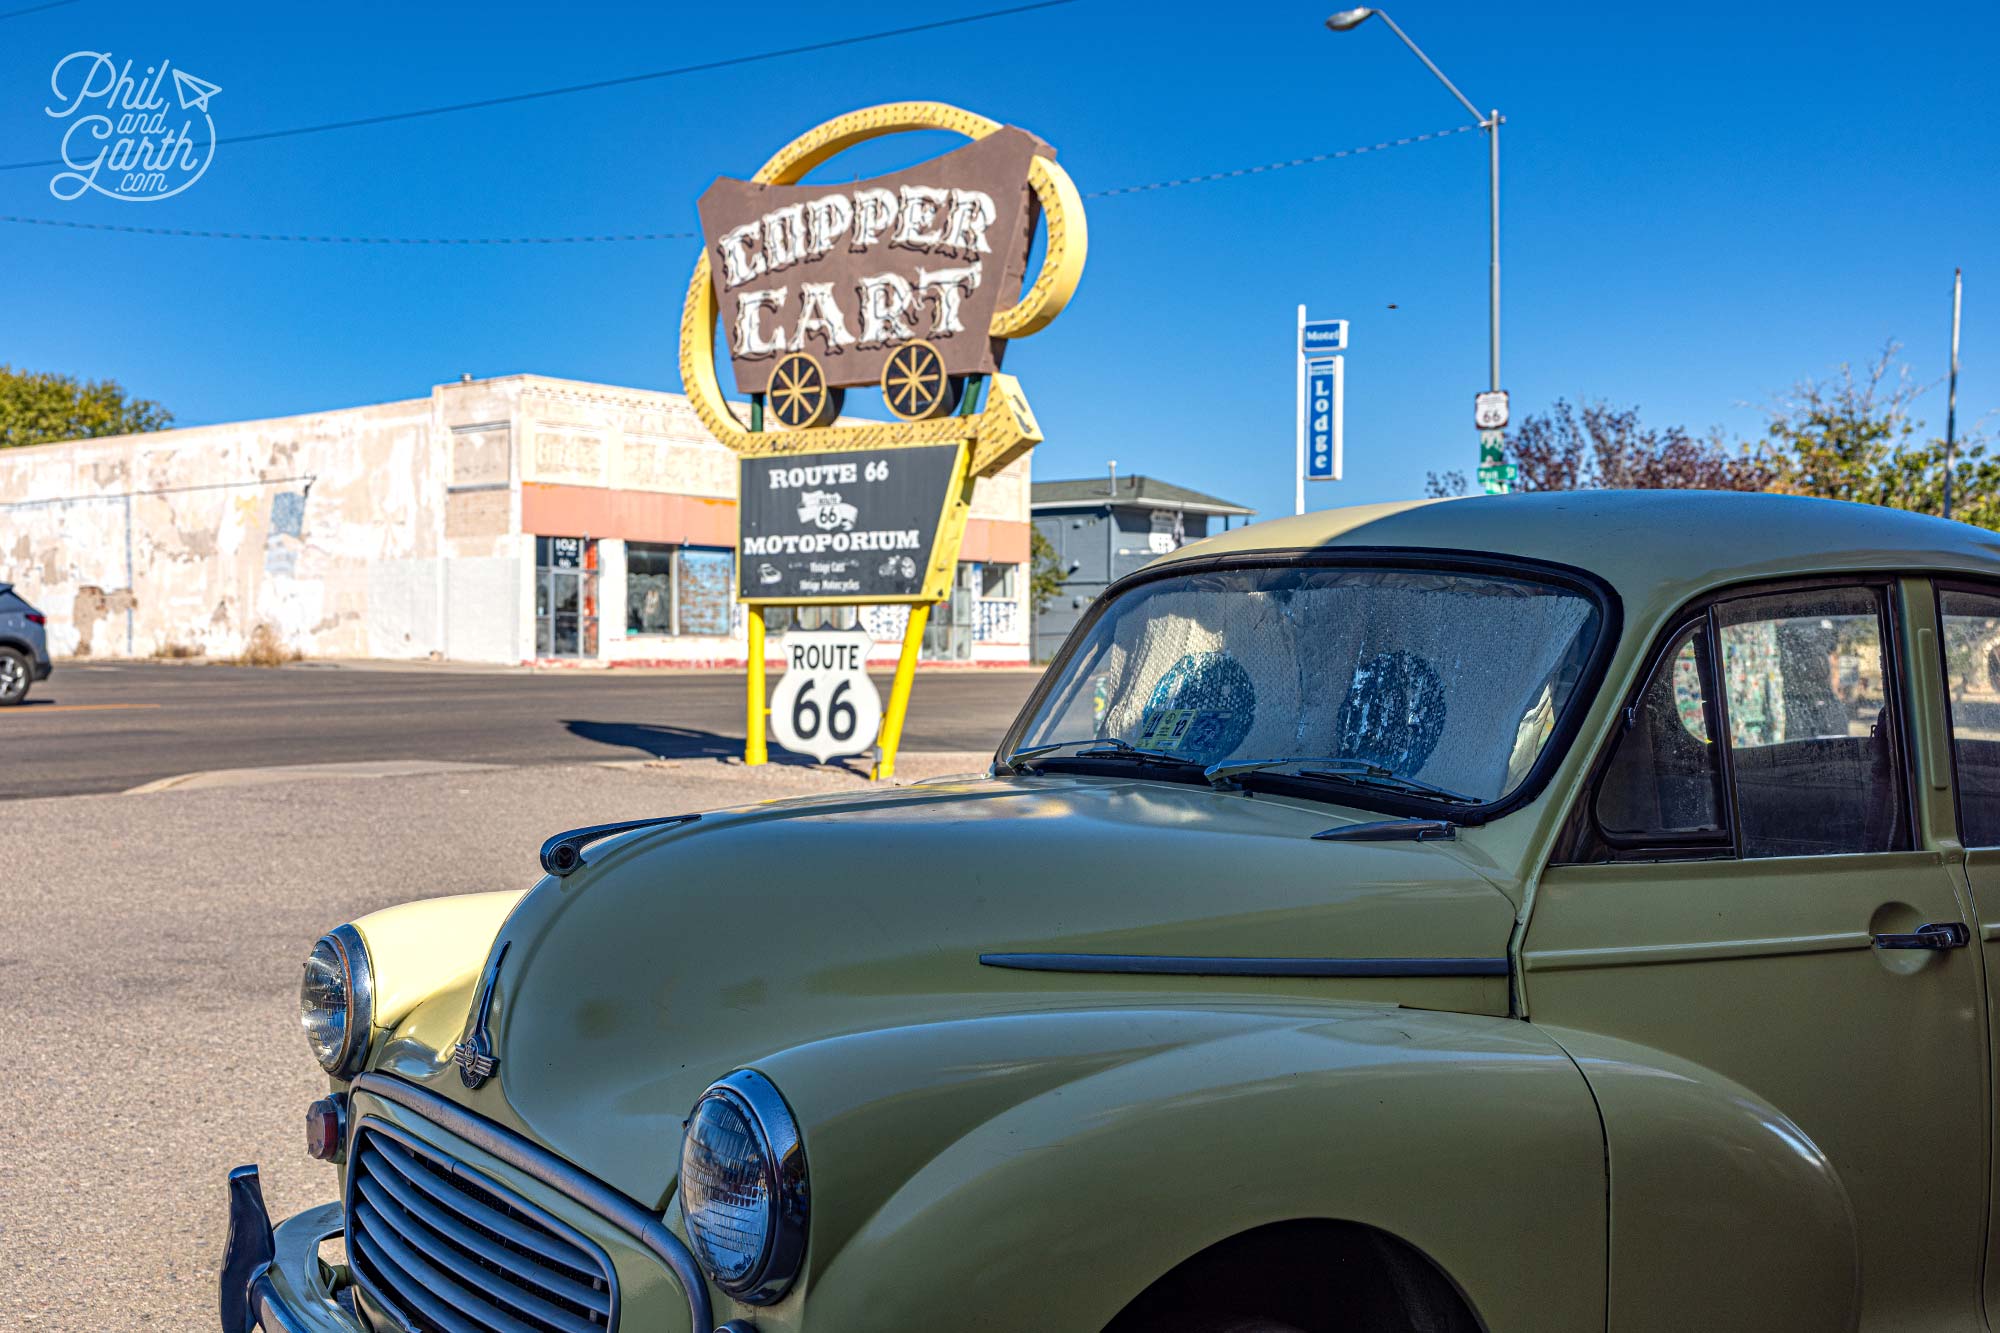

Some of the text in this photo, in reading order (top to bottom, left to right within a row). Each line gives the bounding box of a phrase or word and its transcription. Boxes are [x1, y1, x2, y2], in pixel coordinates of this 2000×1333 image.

[717, 184, 997, 292] COPPER
[732, 262, 982, 360] CART
[1314, 380, 1330, 469] Lodge
[1483, 410, 1501, 423] 66
[769, 460, 889, 489] ROUTE 66
[820, 506, 837, 524] 66
[555, 538, 577, 551] 102
[743, 530, 920, 555] MOTOPORIUM
[792, 644, 860, 671] ROUTE
[792, 678, 857, 742] 66
